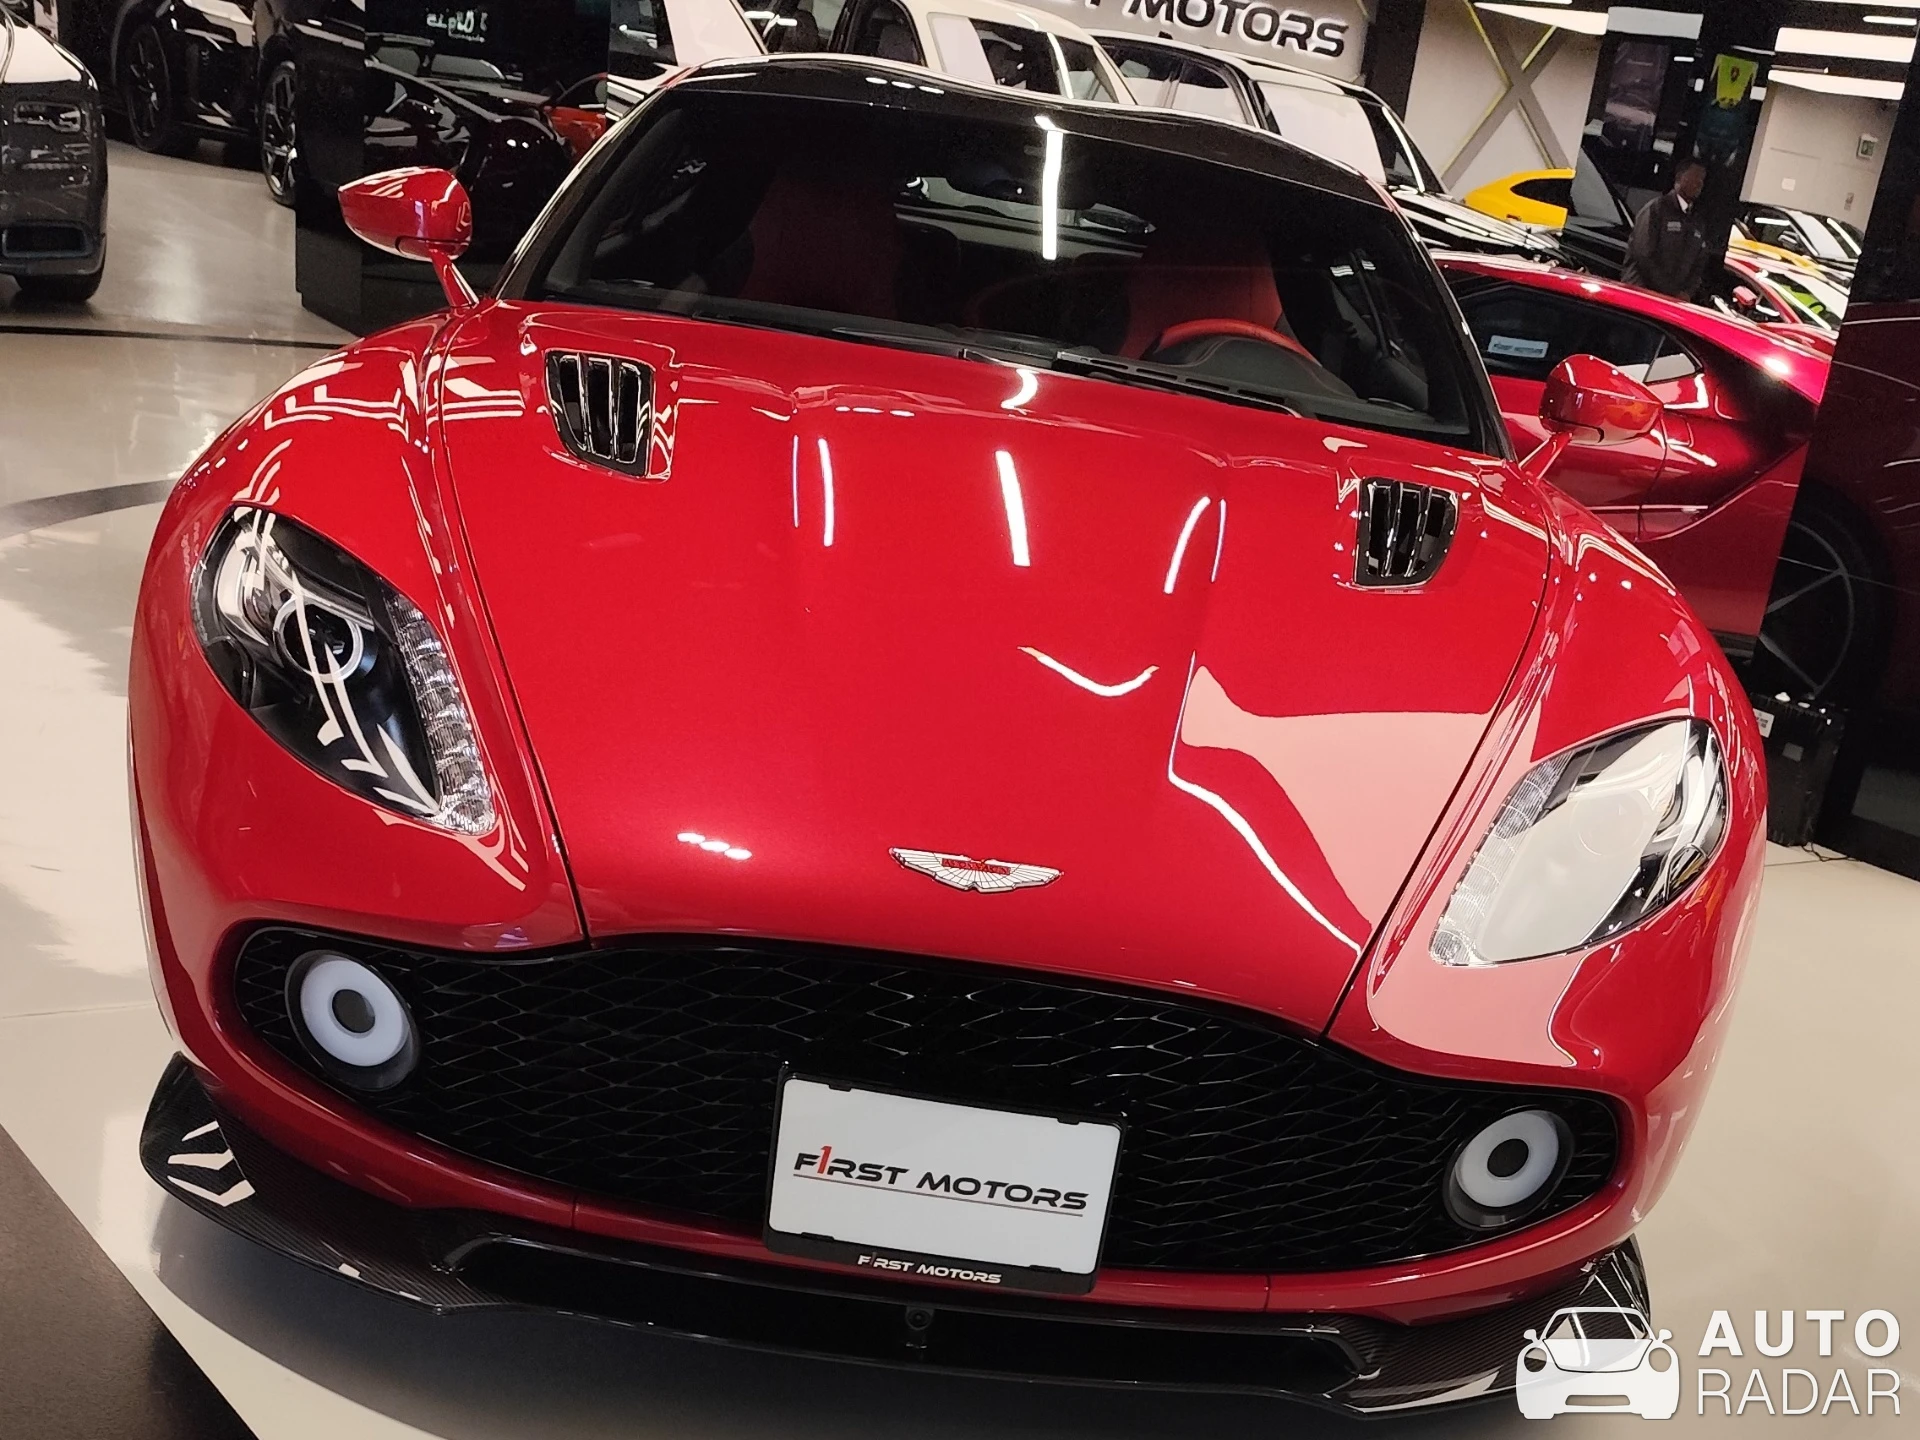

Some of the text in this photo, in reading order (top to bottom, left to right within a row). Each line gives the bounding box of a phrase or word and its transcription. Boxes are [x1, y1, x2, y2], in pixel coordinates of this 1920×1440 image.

[1127, 0, 1349, 58] MOTORS
[916, 1171, 1090, 1211] MOTORS
[916, 1263, 1002, 1284] MOTORS
